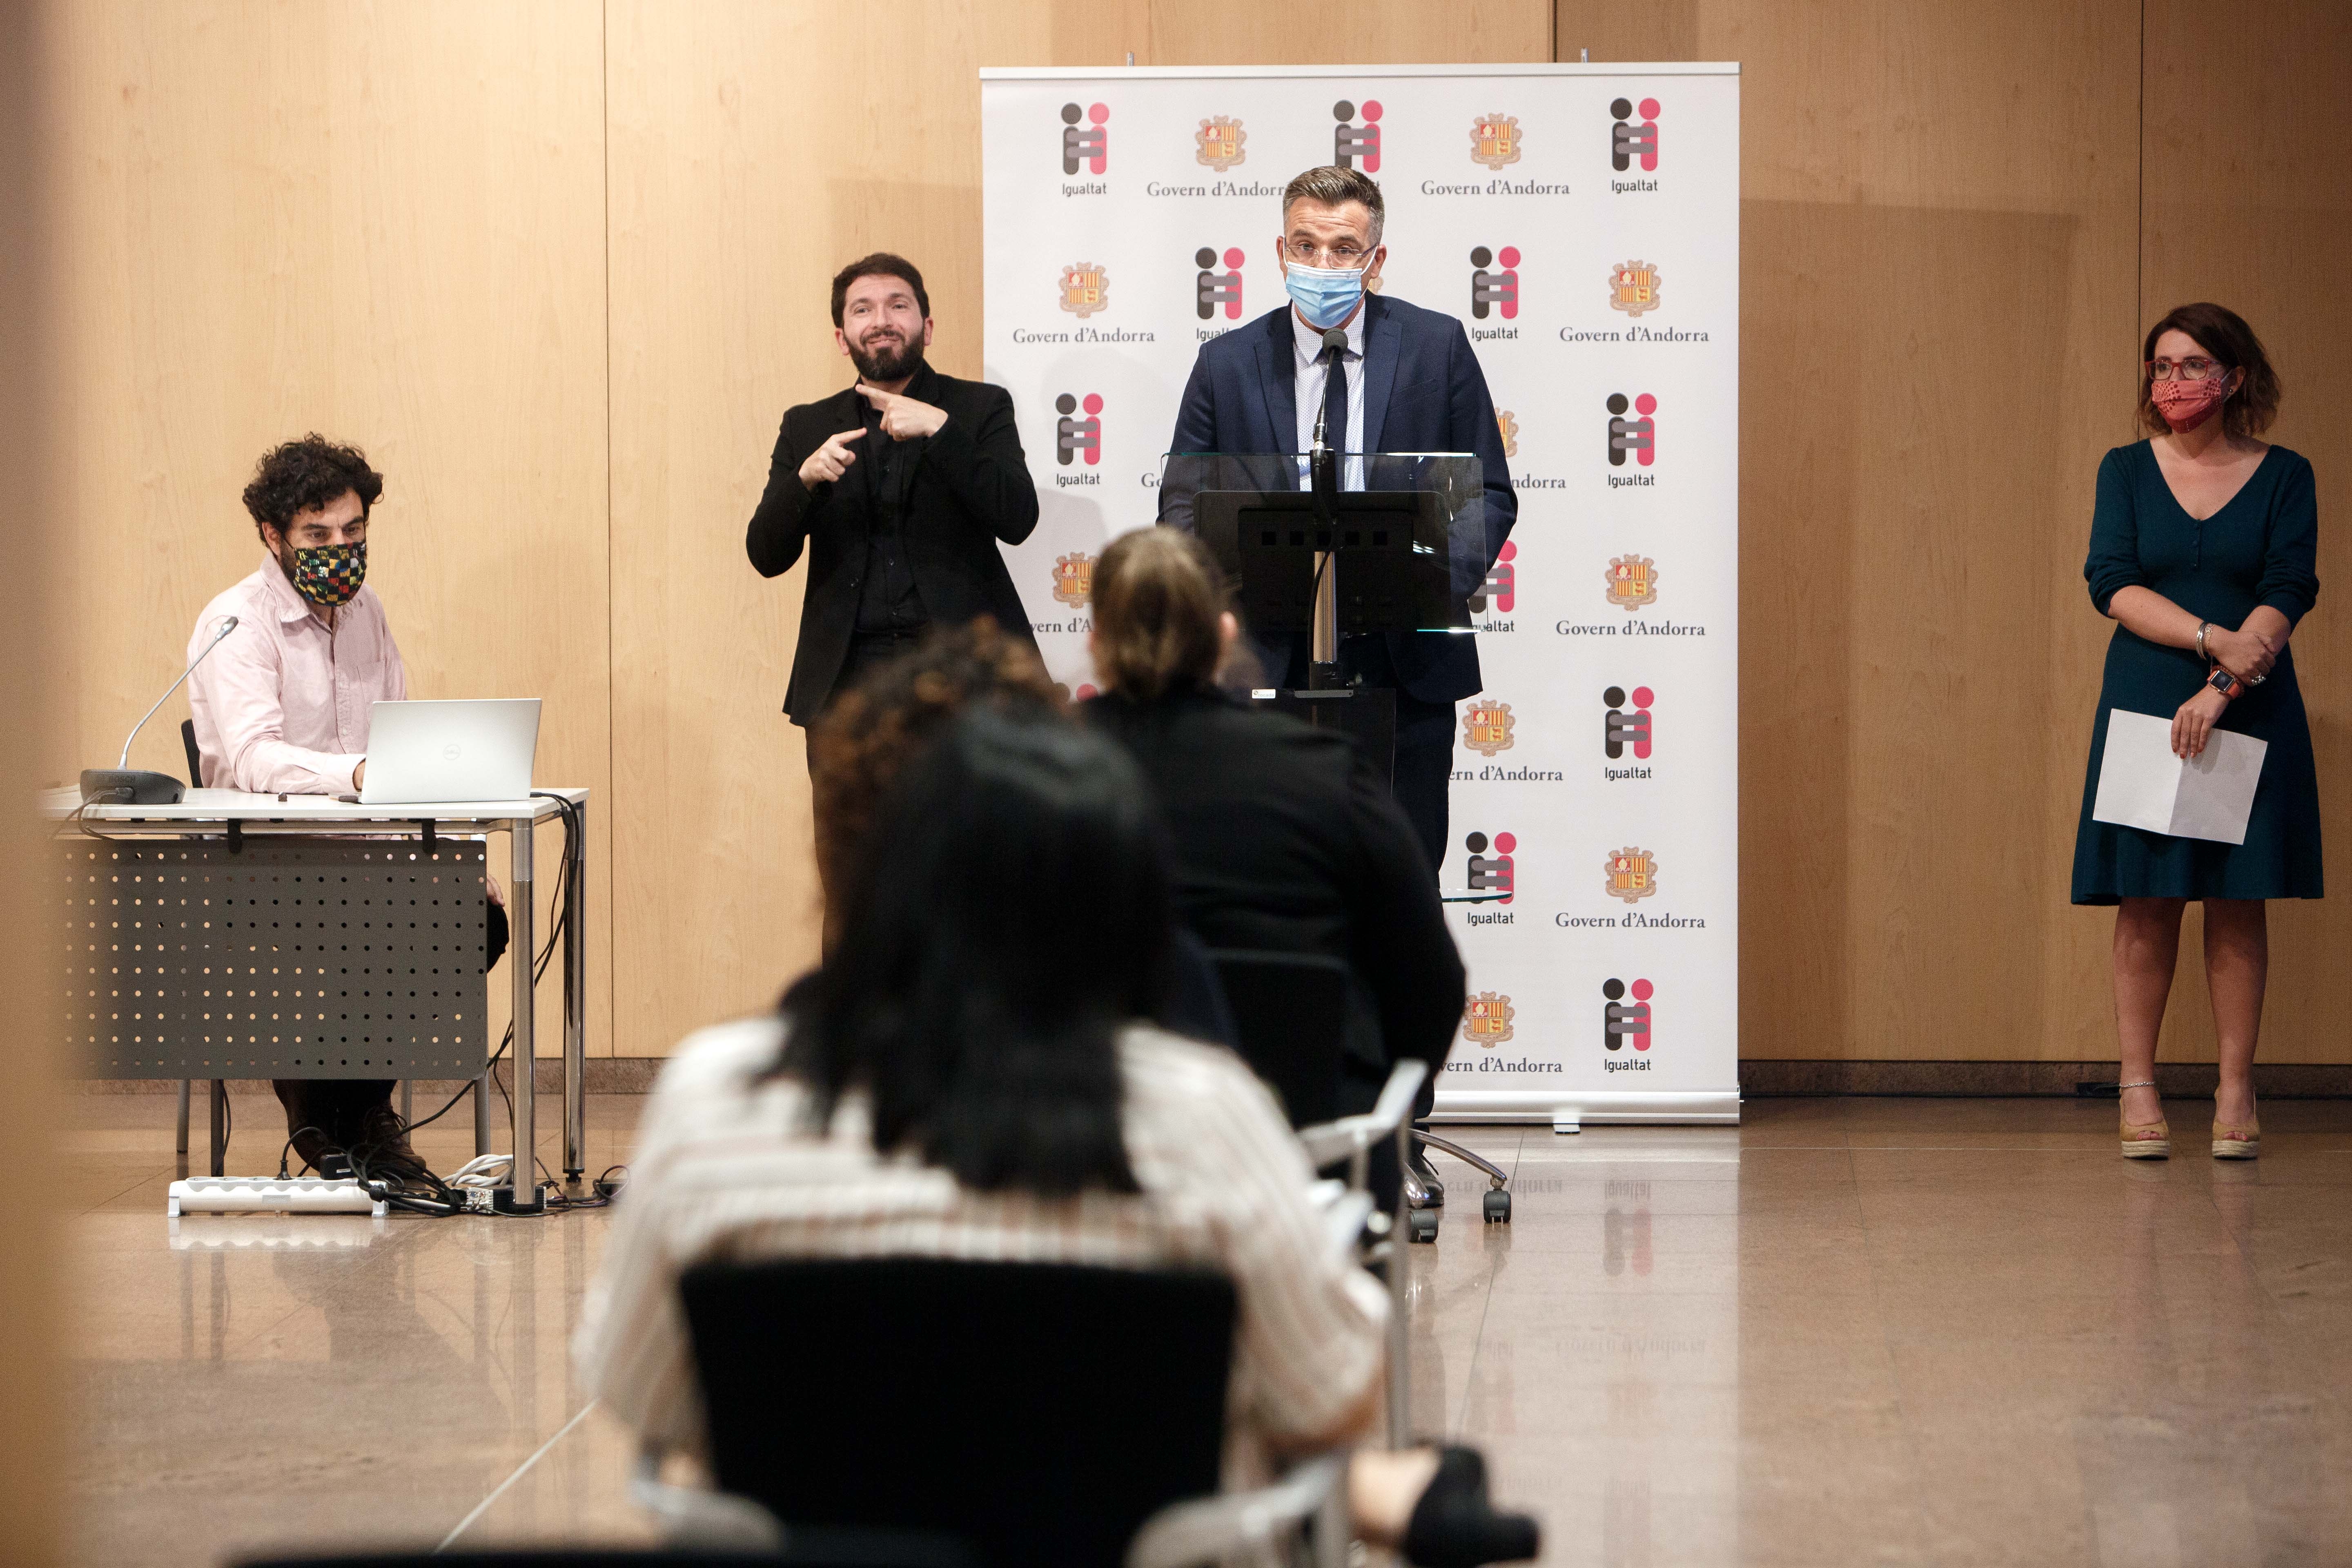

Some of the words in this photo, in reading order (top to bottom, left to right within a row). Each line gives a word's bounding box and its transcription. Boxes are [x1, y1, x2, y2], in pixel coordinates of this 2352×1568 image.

[1062, 183, 1107, 198] Igualtat
[1147, 182, 1206, 196] Govern
[1211, 181, 1285, 196] d'Andorr
[1421, 180, 1481, 195] Govern
[1486, 179, 1570, 195] d'Andorra
[1612, 179, 1658, 194] Igualtat
[1013, 329, 1069, 343] Govern
[1074, 327, 1155, 343] d'Andorra
[1196, 327, 1229, 341] Igual
[1472, 327, 1518, 342] Igualtat
[1559, 327, 1620, 342] Govern
[1626, 326, 1709, 342] d'Andorra
[1056, 473, 1100, 488] Igualtat
[1511, 473, 1567, 488] ndorra
[1608, 474, 1655, 489] Igualtat
[1029, 623, 1062, 632] vern
[1556, 620, 1616, 635] Govern
[1622, 620, 1706, 636] d'Andorra
[1450, 771, 1474, 780] ern
[1479, 765, 1563, 781] d'Andorra
[1605, 766, 1652, 782] Igualtat
[1468, 912, 1514, 927] Igualtat
[1555, 912, 1616, 927] Govern
[1621, 912, 1706, 928] d'Andorra
[1479, 1057, 1563, 1073] d'Andorra
[1604, 1058, 1651, 1073] Igualtat
